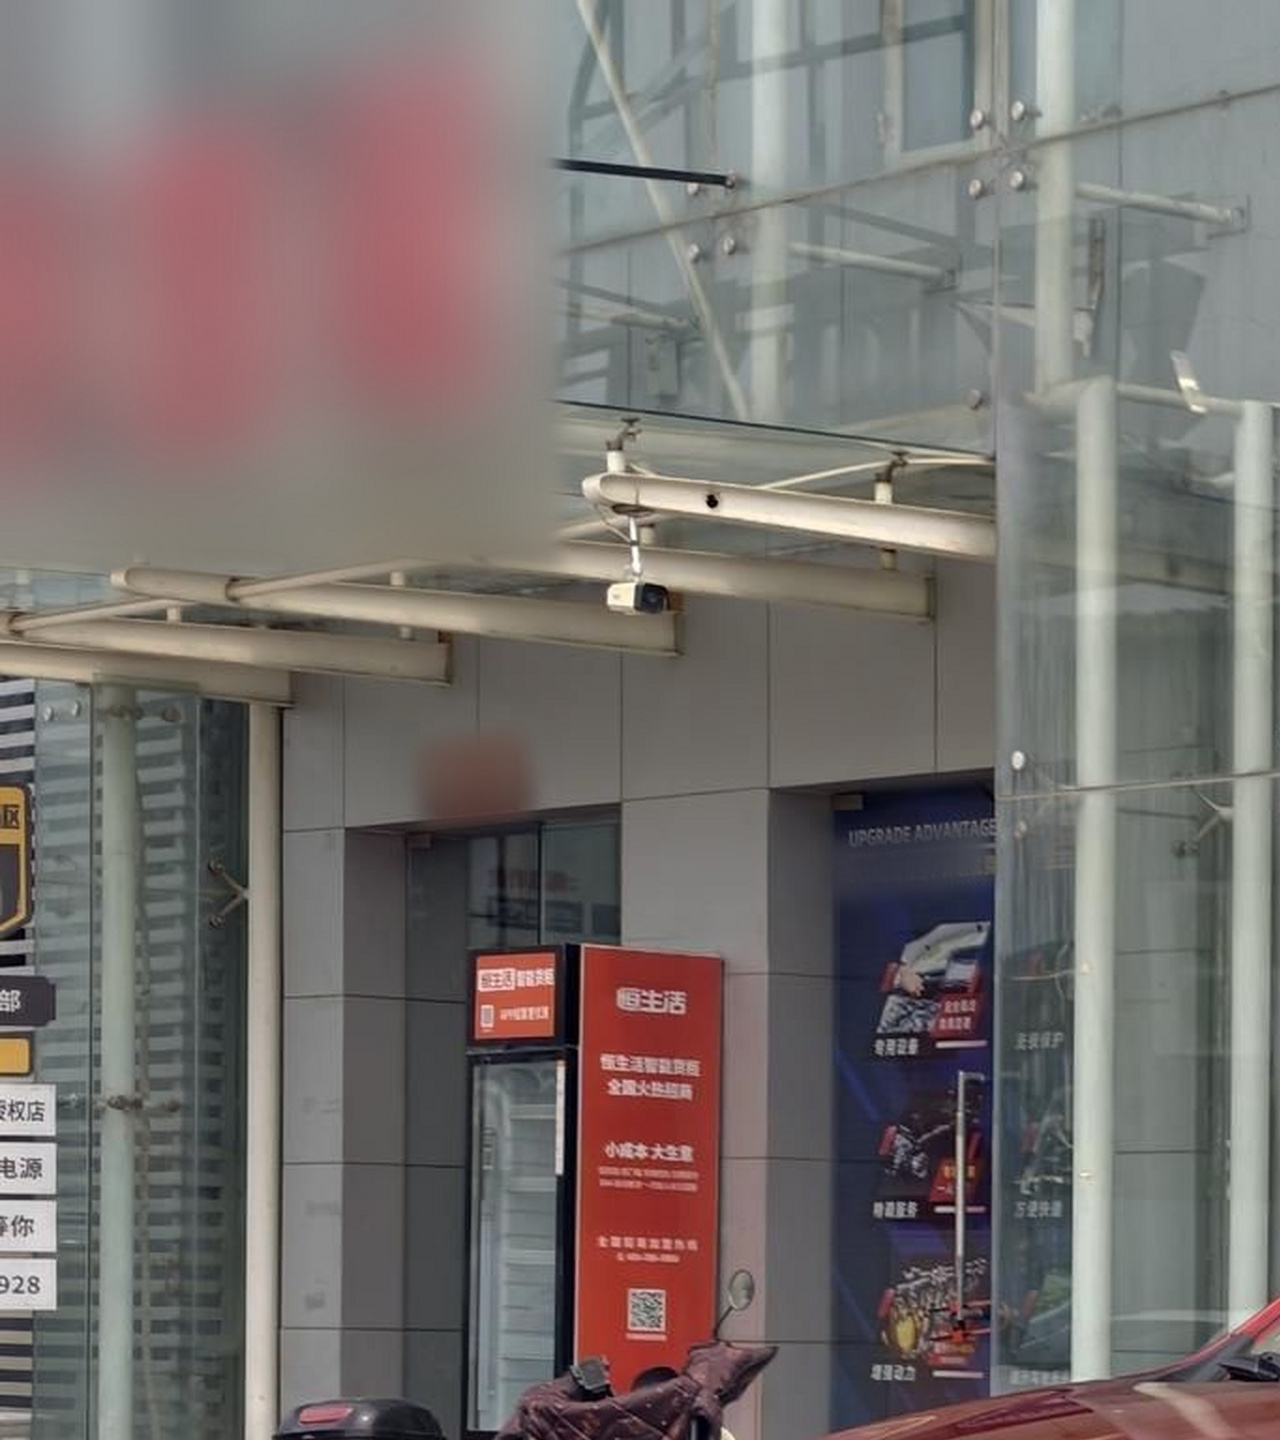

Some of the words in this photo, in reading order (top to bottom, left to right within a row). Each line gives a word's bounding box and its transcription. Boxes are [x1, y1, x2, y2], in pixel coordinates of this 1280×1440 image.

[848, 825, 912, 848] UPGRADE
[616, 986, 687, 1016] 恒生活
